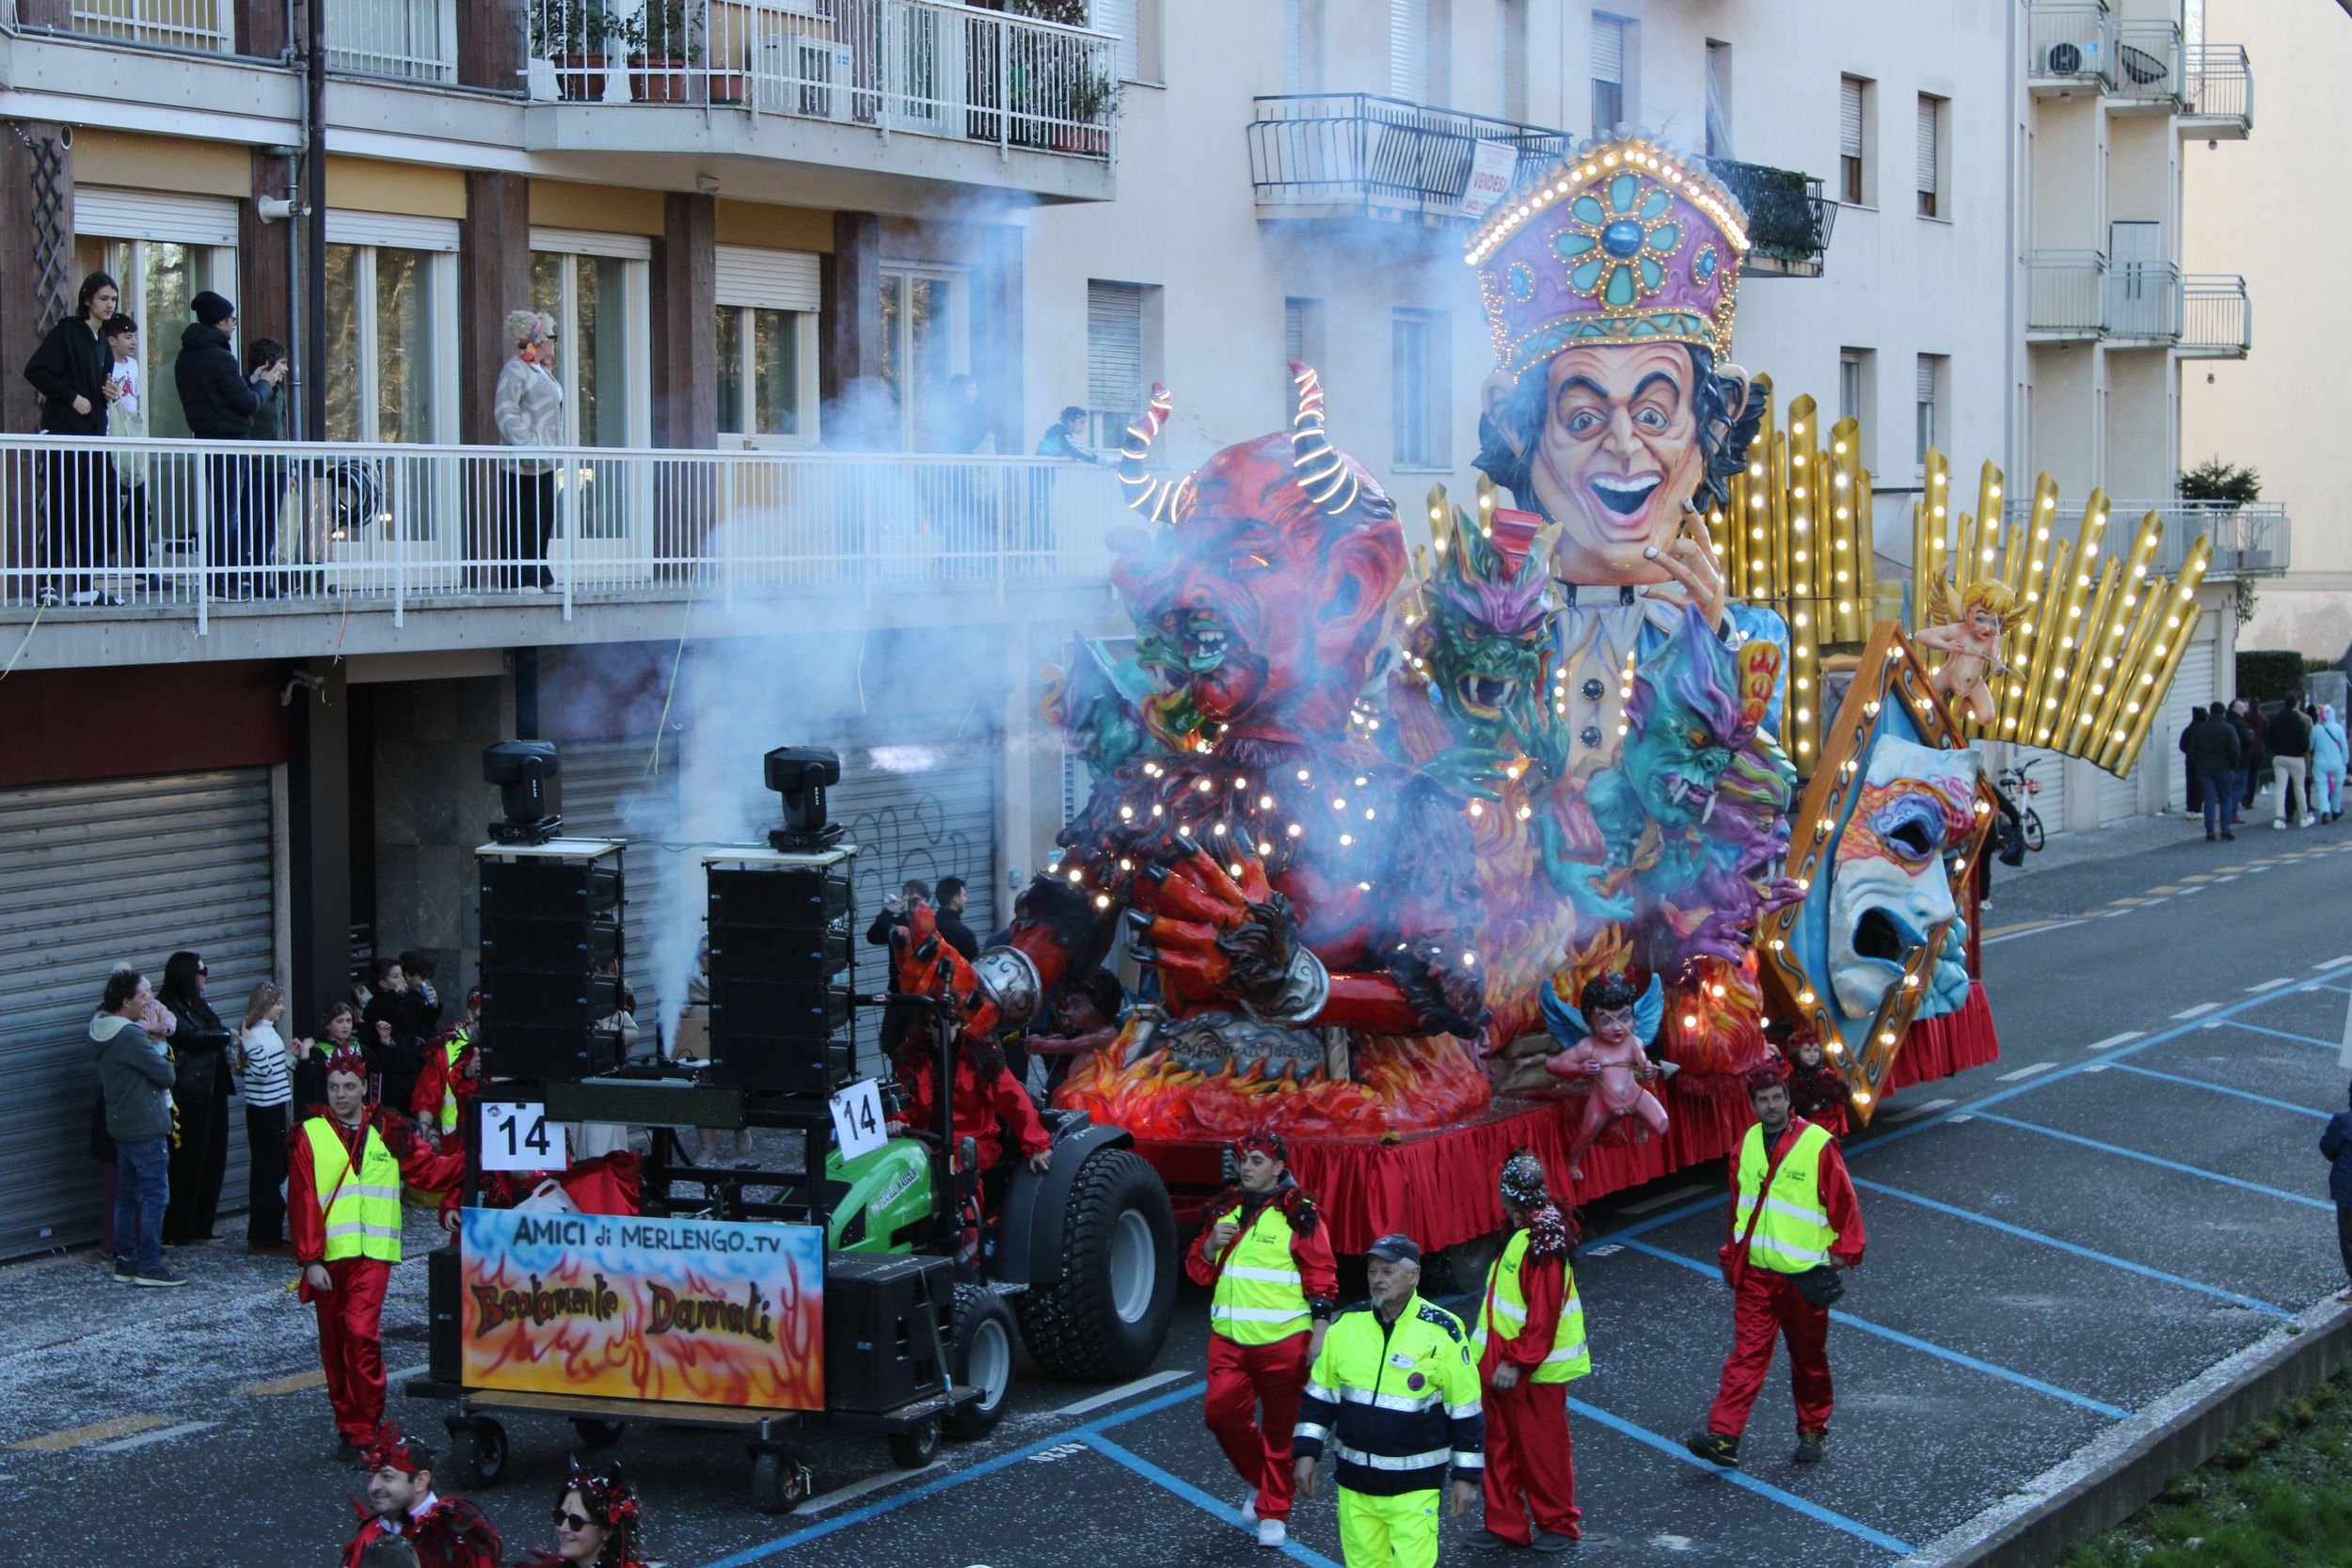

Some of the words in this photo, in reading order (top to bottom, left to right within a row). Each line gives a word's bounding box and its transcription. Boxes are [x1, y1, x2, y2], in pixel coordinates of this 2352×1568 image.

[1473, 172, 1507, 193] VENDESI
[499, 1115, 550, 1156] 14
[843, 1094, 876, 1141] 14
[513, 1215, 586, 1246] AMICI
[595, 1225, 612, 1247] di
[471, 1273, 619, 1339] Beatamente
[645, 1279, 774, 1343] Dannati
